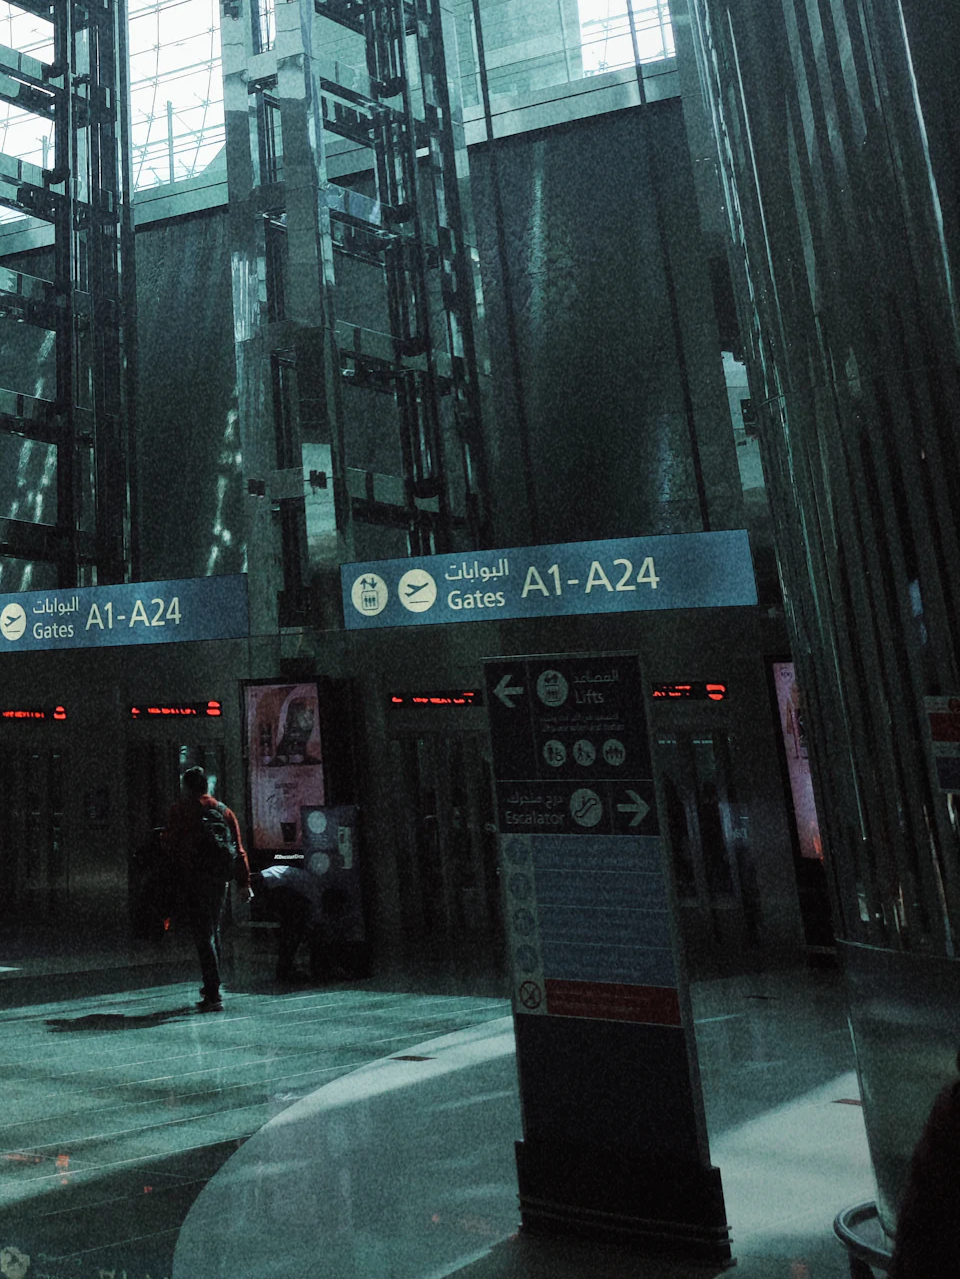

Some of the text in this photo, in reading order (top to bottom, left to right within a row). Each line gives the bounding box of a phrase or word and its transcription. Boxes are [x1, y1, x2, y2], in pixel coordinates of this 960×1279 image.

[444, 558, 509, 583] البوابات
[447, 556, 660, 610] Gates A1-A24
[33, 596, 79, 616] البوابات
[33, 597, 182, 639] Gates A1-A24
[574, 689, 605, 705] Lifts
[505, 810, 566, 825] Escalator
